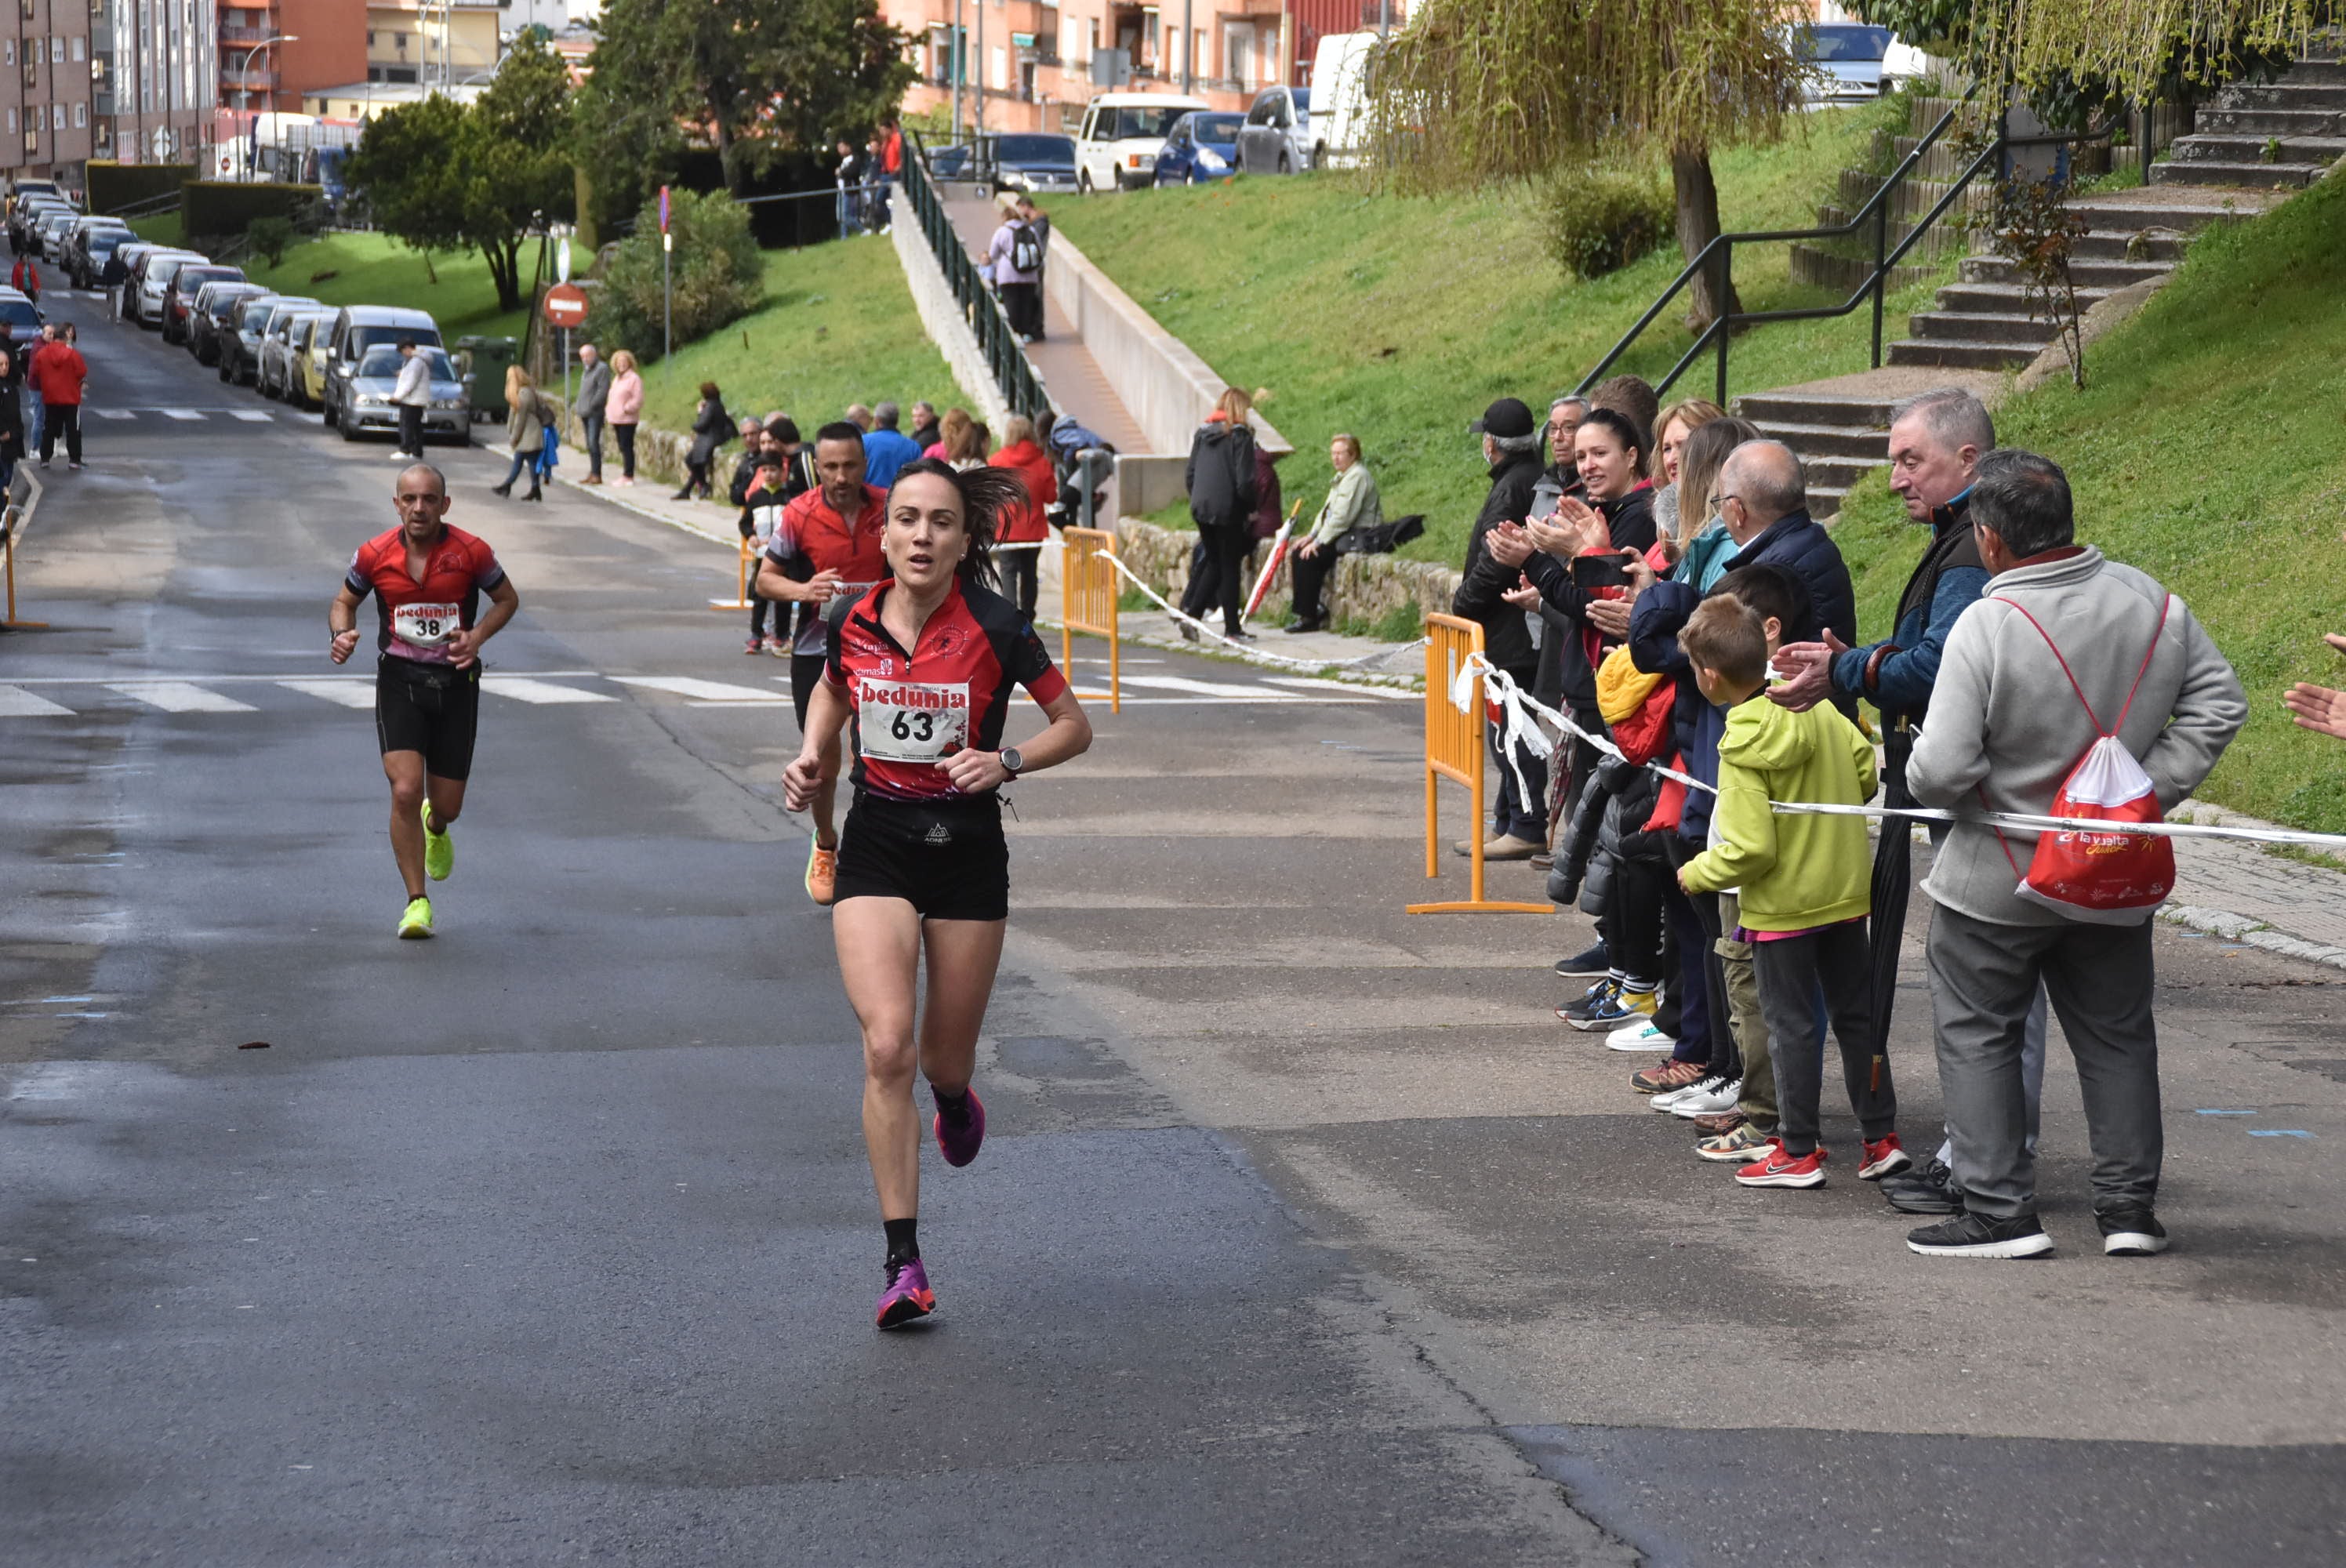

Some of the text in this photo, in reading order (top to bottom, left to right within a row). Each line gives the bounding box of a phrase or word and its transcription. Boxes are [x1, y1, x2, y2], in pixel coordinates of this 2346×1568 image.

[416, 619, 440, 636] 38
[862, 681, 966, 709] bedunia
[892, 710, 933, 742] 63
[2079, 831, 2130, 846] la vuelta
